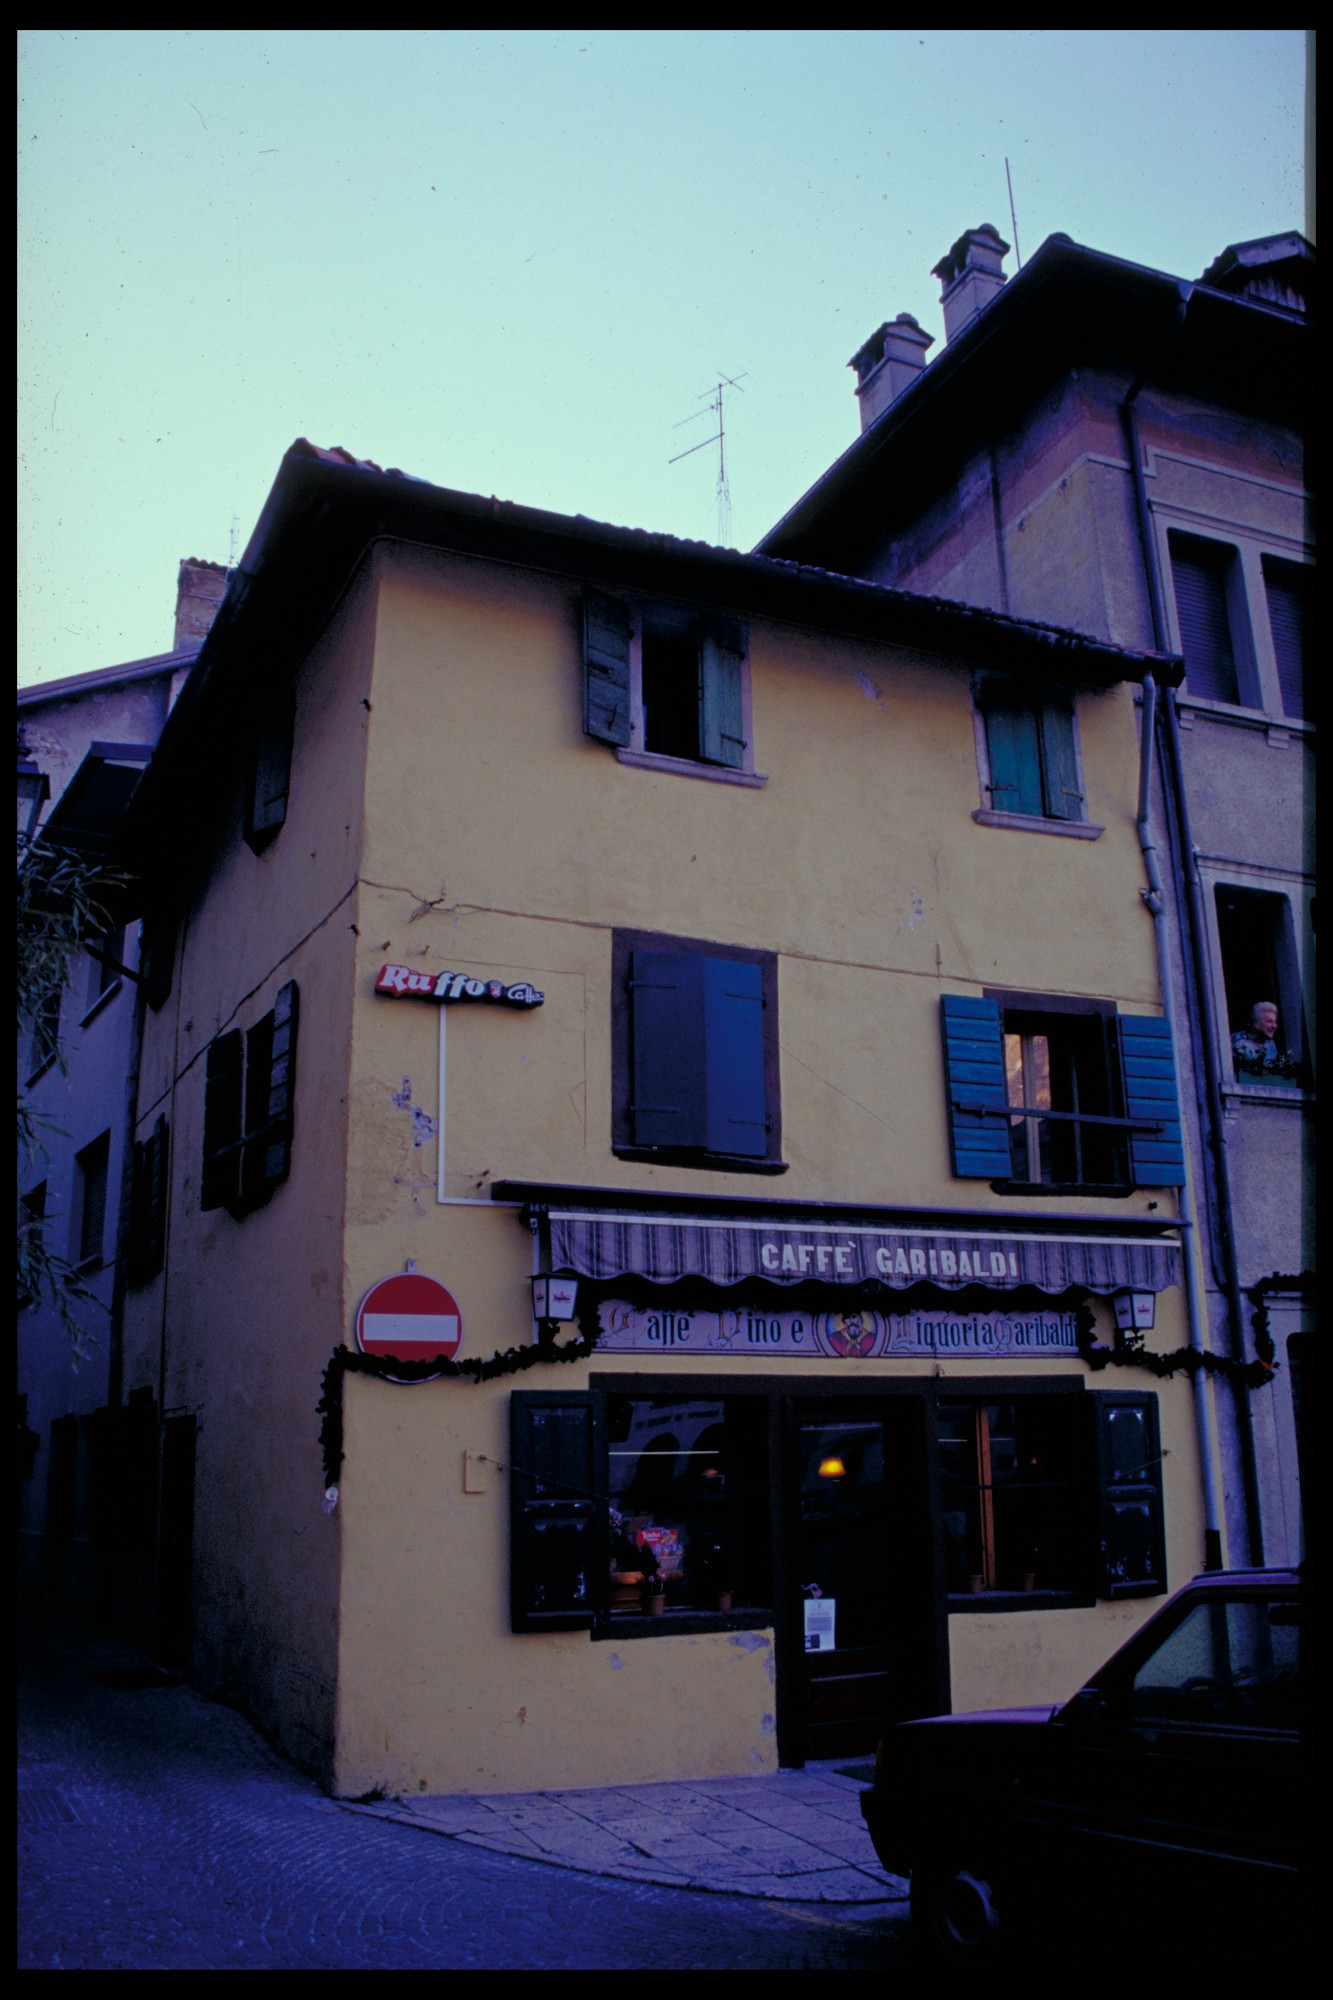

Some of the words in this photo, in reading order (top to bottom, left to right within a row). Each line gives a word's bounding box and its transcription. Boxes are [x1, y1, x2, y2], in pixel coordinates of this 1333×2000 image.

[379, 964, 485, 998] Ruffo
[760, 1240, 856, 1274] CAFFÈ
[875, 1247, 1018, 1278] GARIBALDI
[791, 1317, 804, 1344] e
